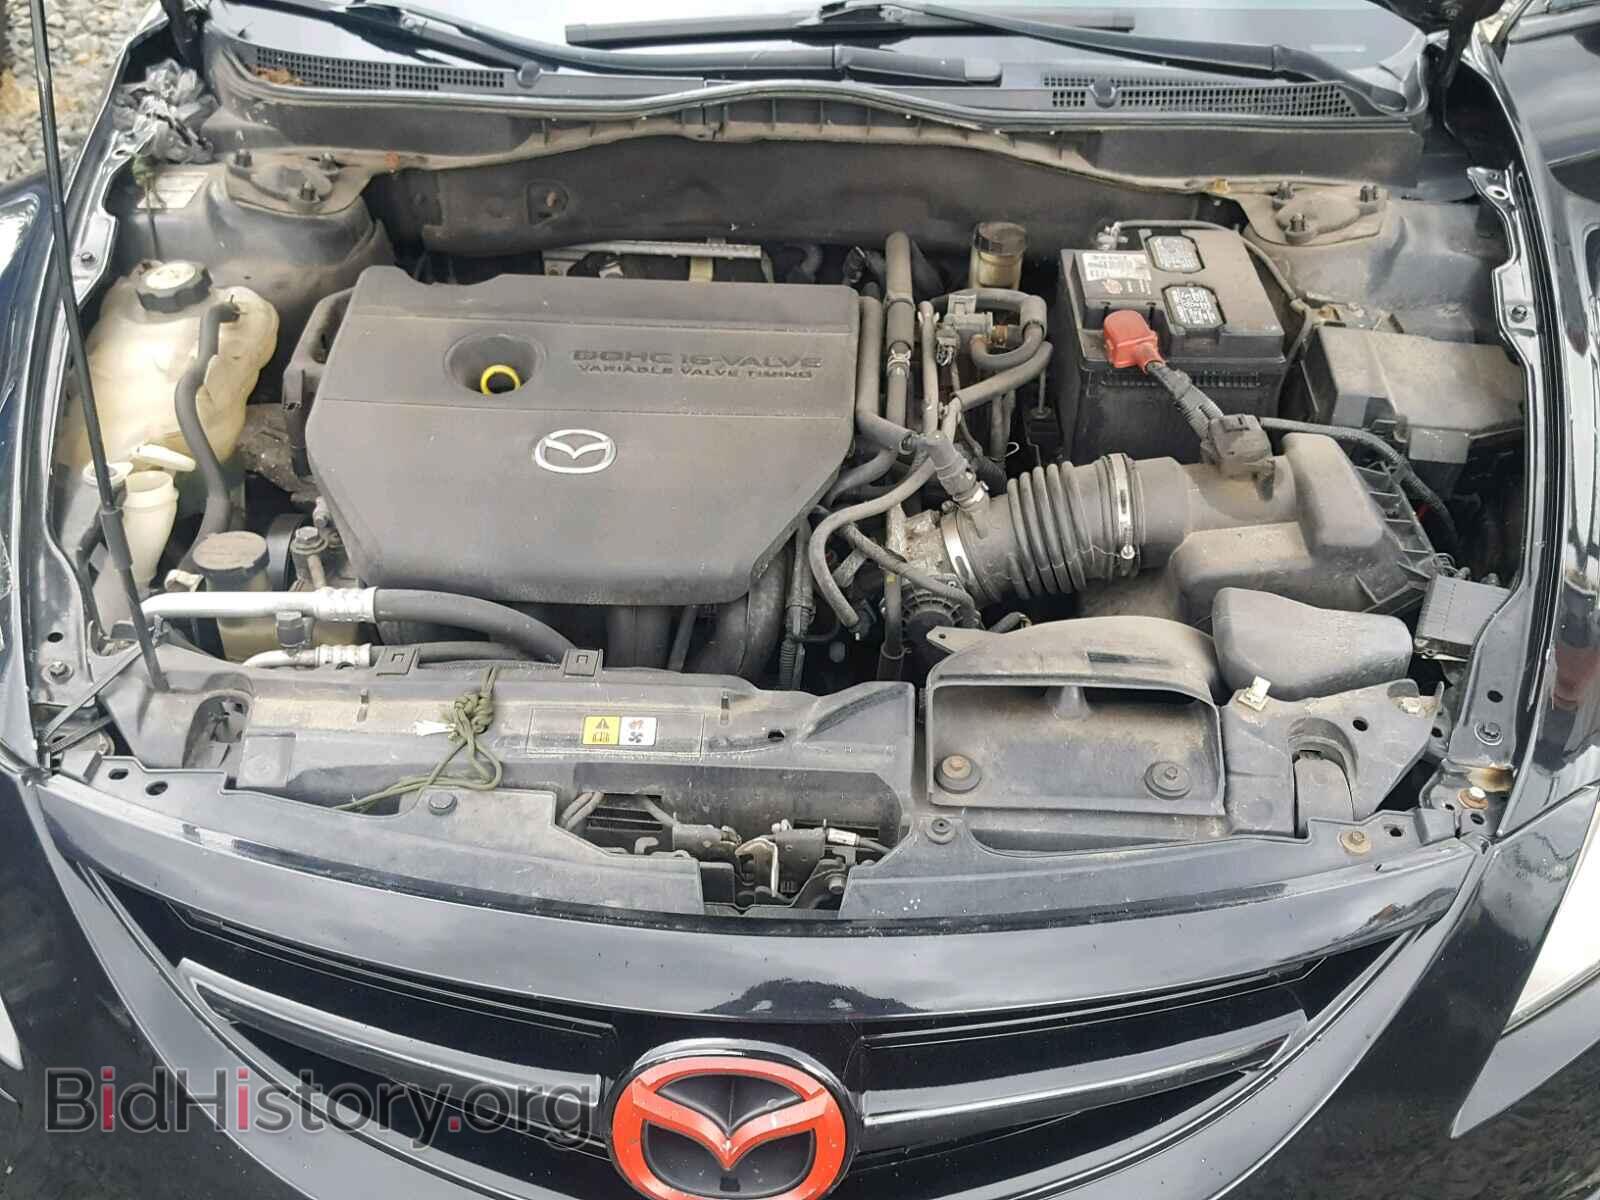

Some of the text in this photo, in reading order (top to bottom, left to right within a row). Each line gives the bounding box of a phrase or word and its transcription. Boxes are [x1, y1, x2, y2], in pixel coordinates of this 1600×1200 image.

[681, 352, 823, 368] 16-VALVE
[577, 363, 673, 375] VARIABLE
[680, 367, 740, 377] VALVE
